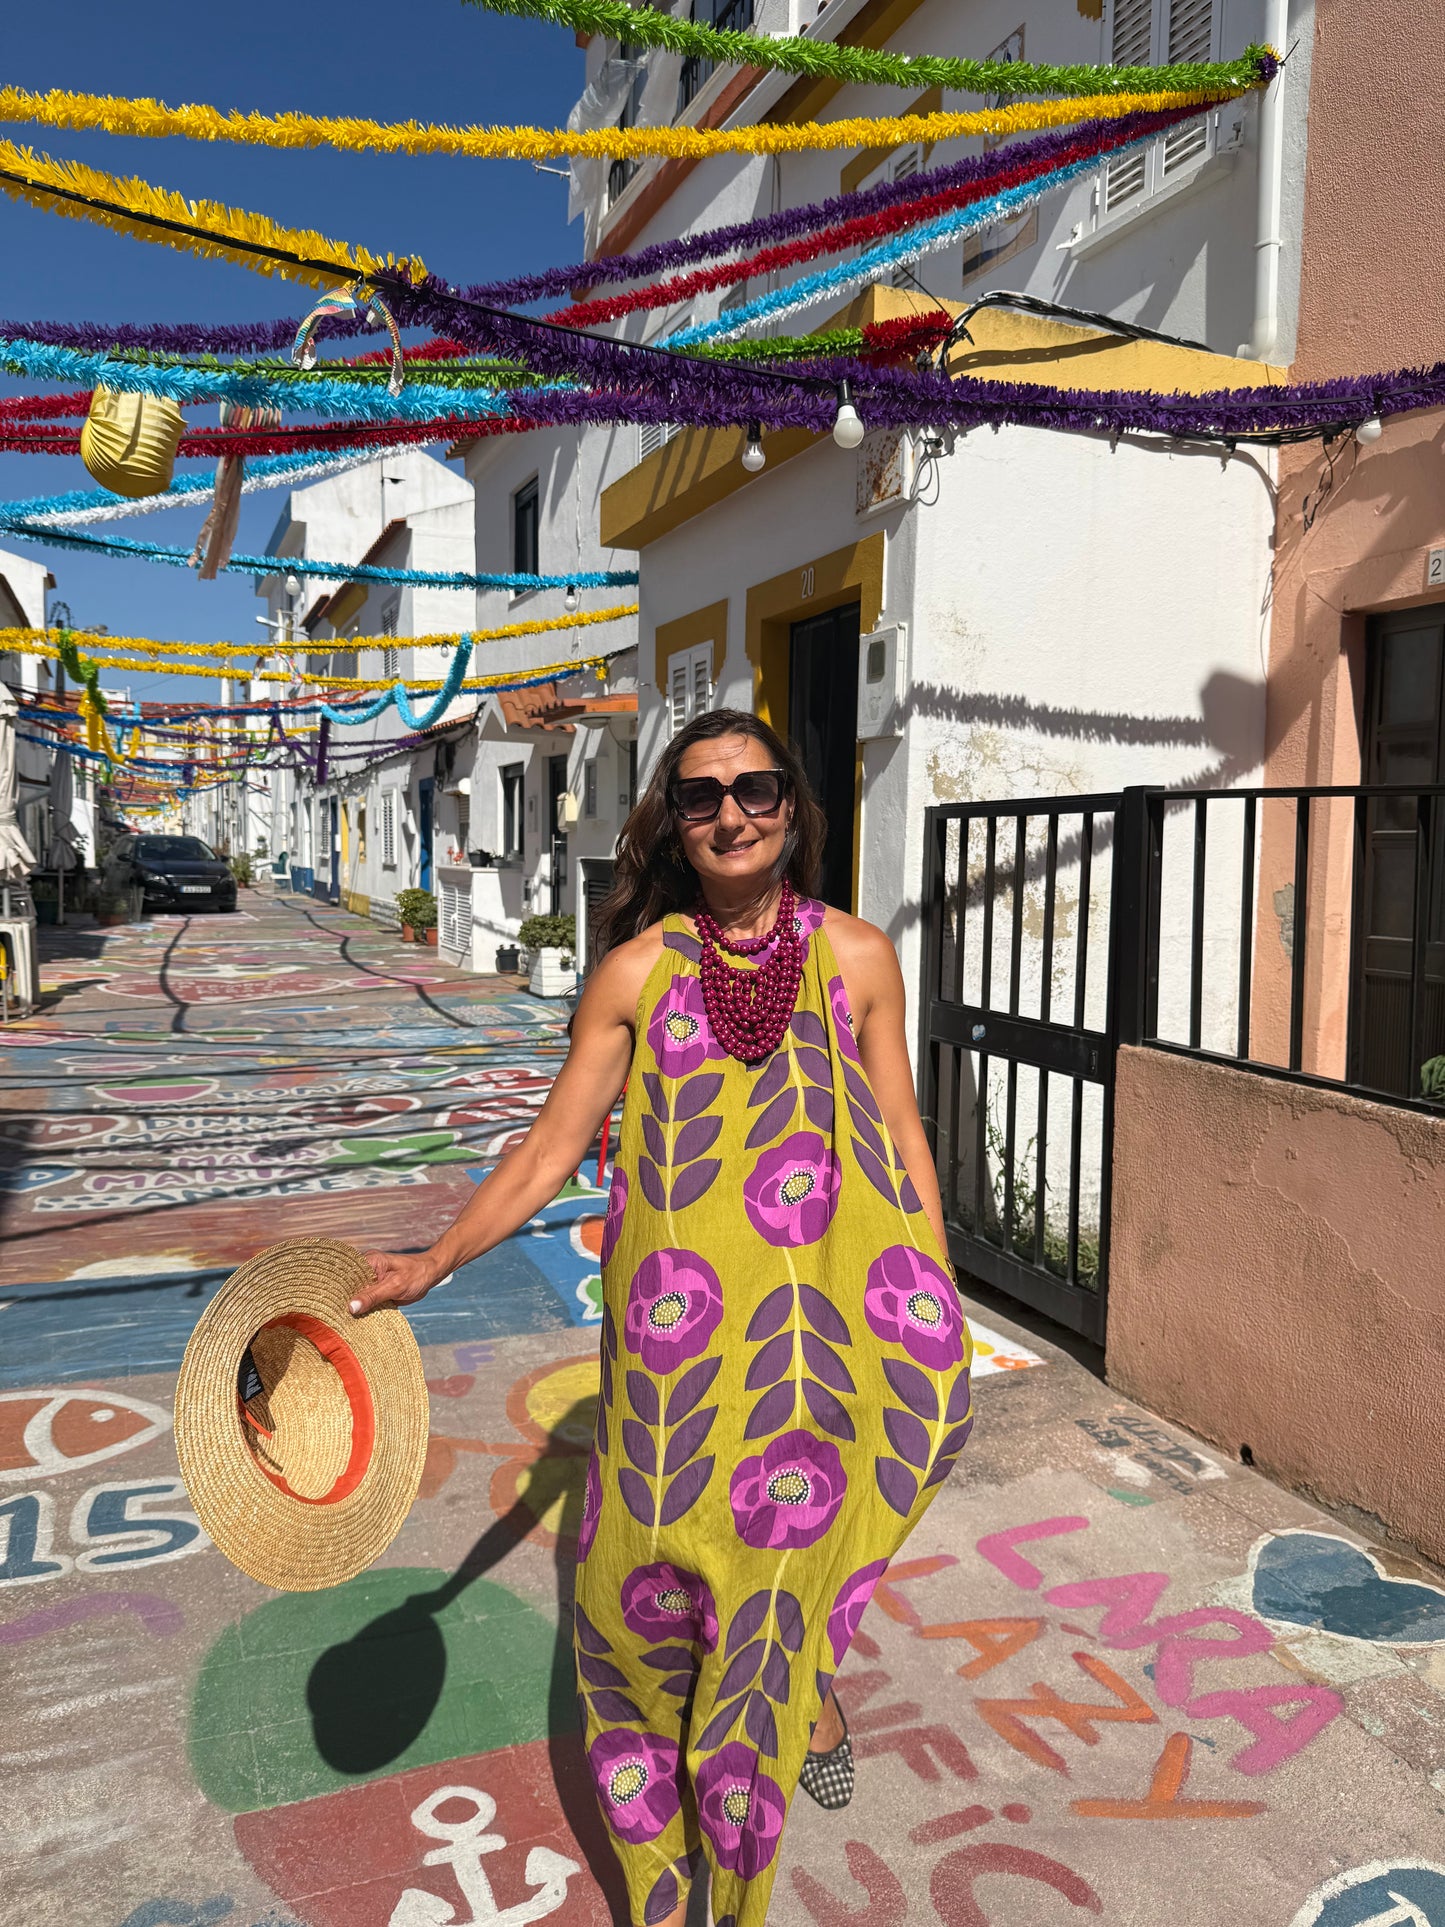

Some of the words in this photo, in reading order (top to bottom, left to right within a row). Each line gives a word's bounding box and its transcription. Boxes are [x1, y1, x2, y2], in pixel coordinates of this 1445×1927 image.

[801, 567, 815, 600] 20
[217, 1077, 410, 1101] TOMÁS
[138, 1114, 284, 1132] DINIS
[171, 1145, 326, 1168] MARIA
[0, 1477, 213, 1588] 15
[976, 1515, 1346, 1777] LARA
[875, 1554, 1268, 1821] LAZY
